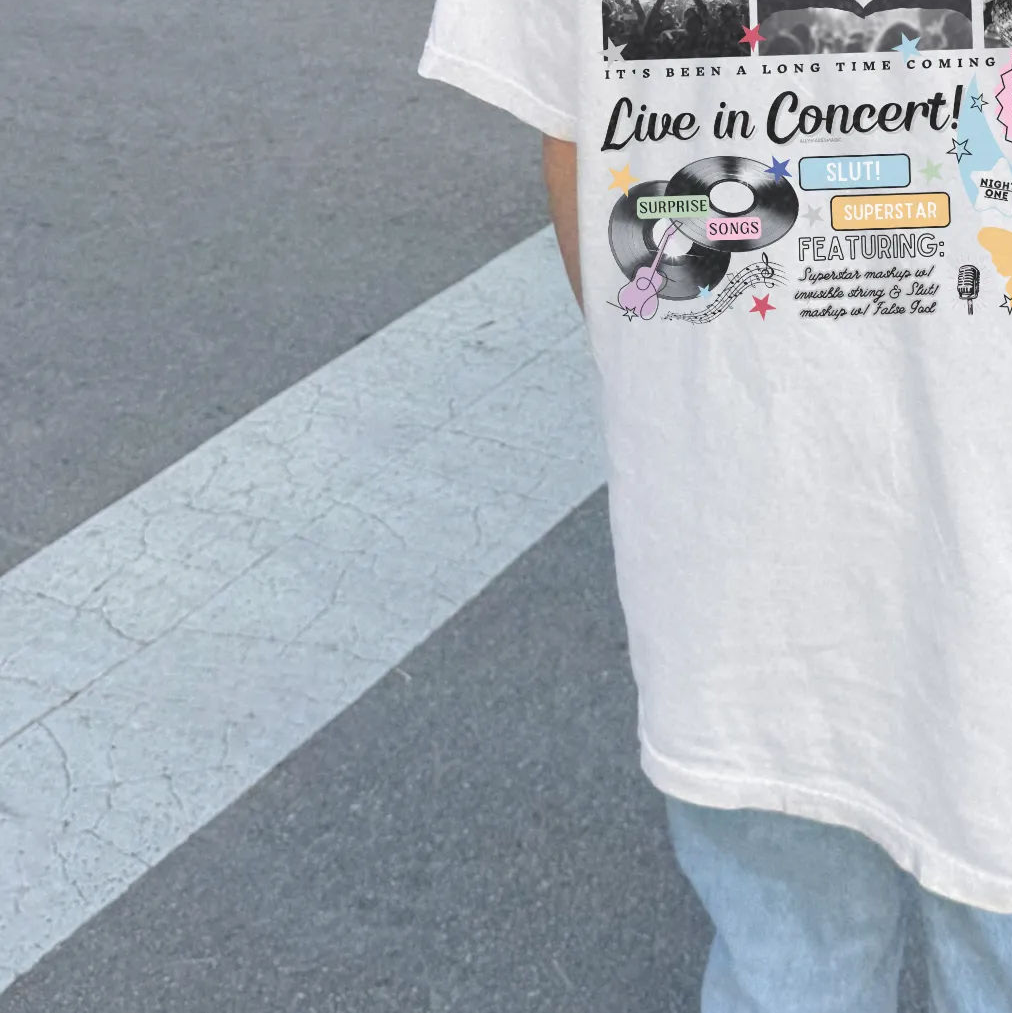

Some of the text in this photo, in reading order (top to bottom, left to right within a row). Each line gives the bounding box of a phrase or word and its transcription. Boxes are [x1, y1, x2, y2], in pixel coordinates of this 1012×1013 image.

[605, 57, 996, 79] IT'S BEEN A LONG TIME COMING
[600, 85, 964, 151] Live in Concert!
[826, 162, 881, 182] SLUT!
[984, 189, 1009, 201] ONE
[639, 199, 708, 214] SURPRISE
[843, 202, 937, 221] SUPERSTAR
[709, 221, 760, 236] SONGS
[798, 233, 945, 262] FEATURING:
[799, 267, 862, 284] Superstar
[864, 267, 912, 282] mashup
[794, 281, 940, 304] invisible string & Slut!
[799, 305, 847, 320] mashup
[873, 301, 906, 315] False
